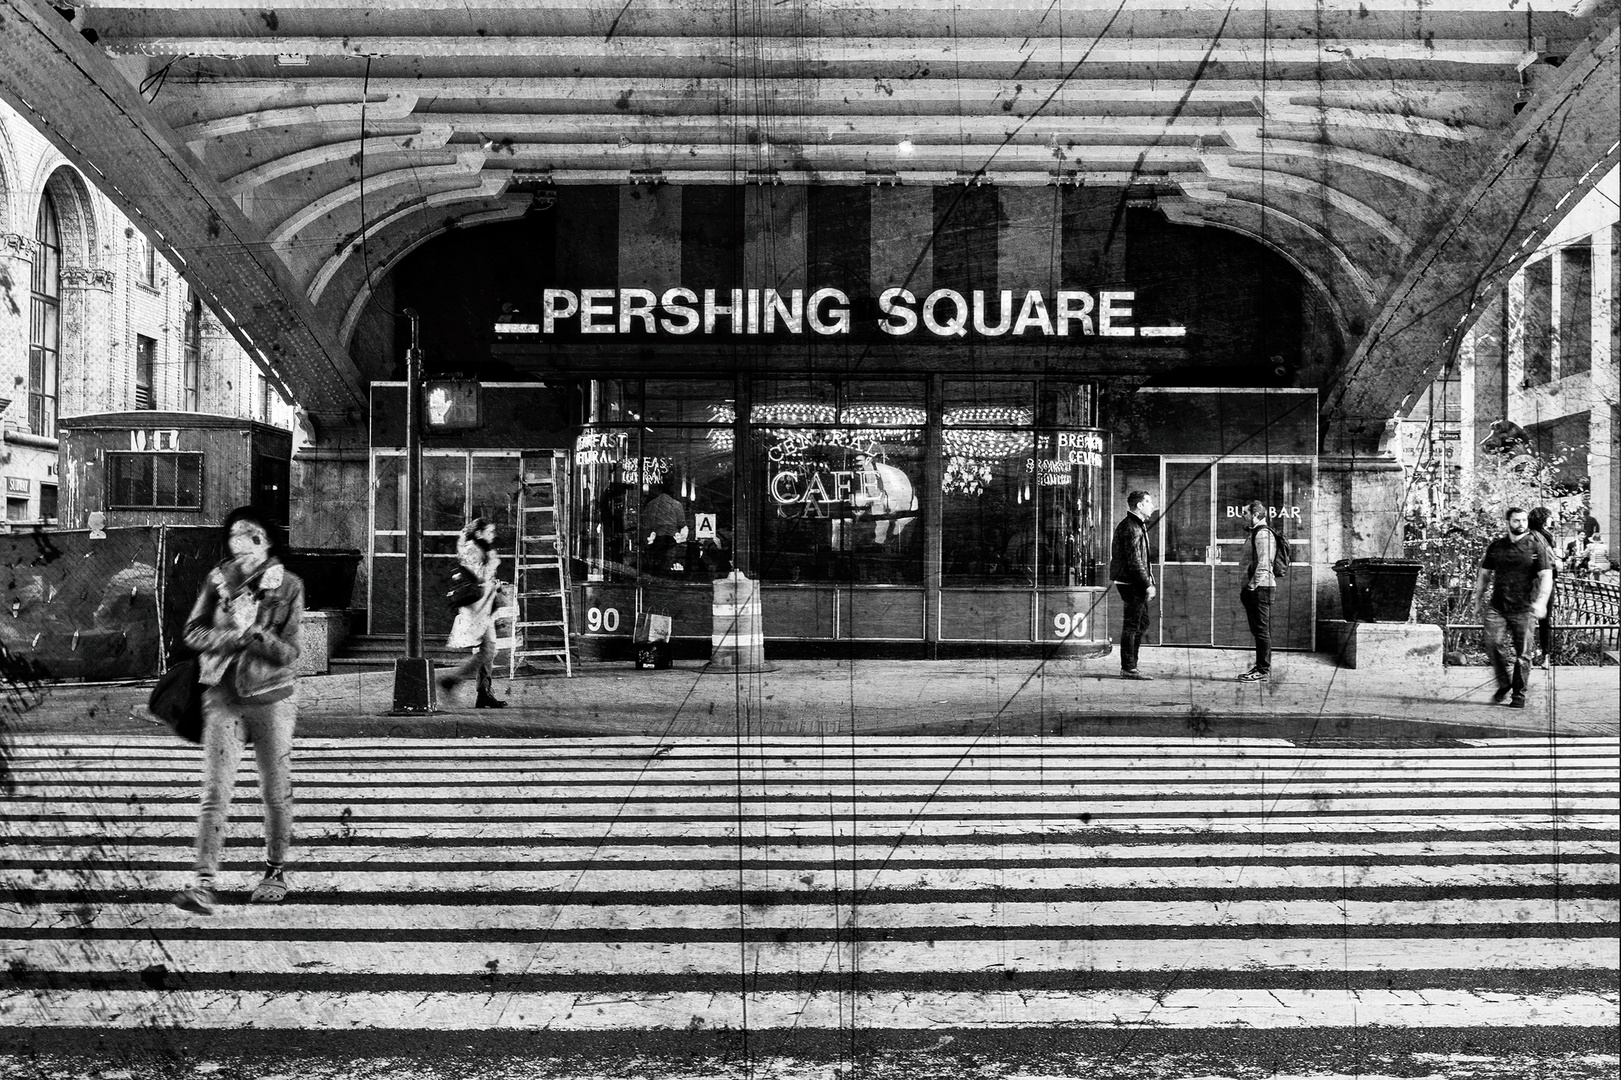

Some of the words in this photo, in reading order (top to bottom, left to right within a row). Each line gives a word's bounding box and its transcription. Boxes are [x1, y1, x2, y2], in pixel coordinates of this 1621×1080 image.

[543, 287, 850, 335] PERSHING
[878, 288, 1136, 337] SQUARE
[768, 430, 878, 462] CENRAL
[699, 517, 713, 532] A
[1268, 506, 1301, 518] BAR
[587, 607, 619, 632] 90
[1053, 612, 1087, 637] 90
